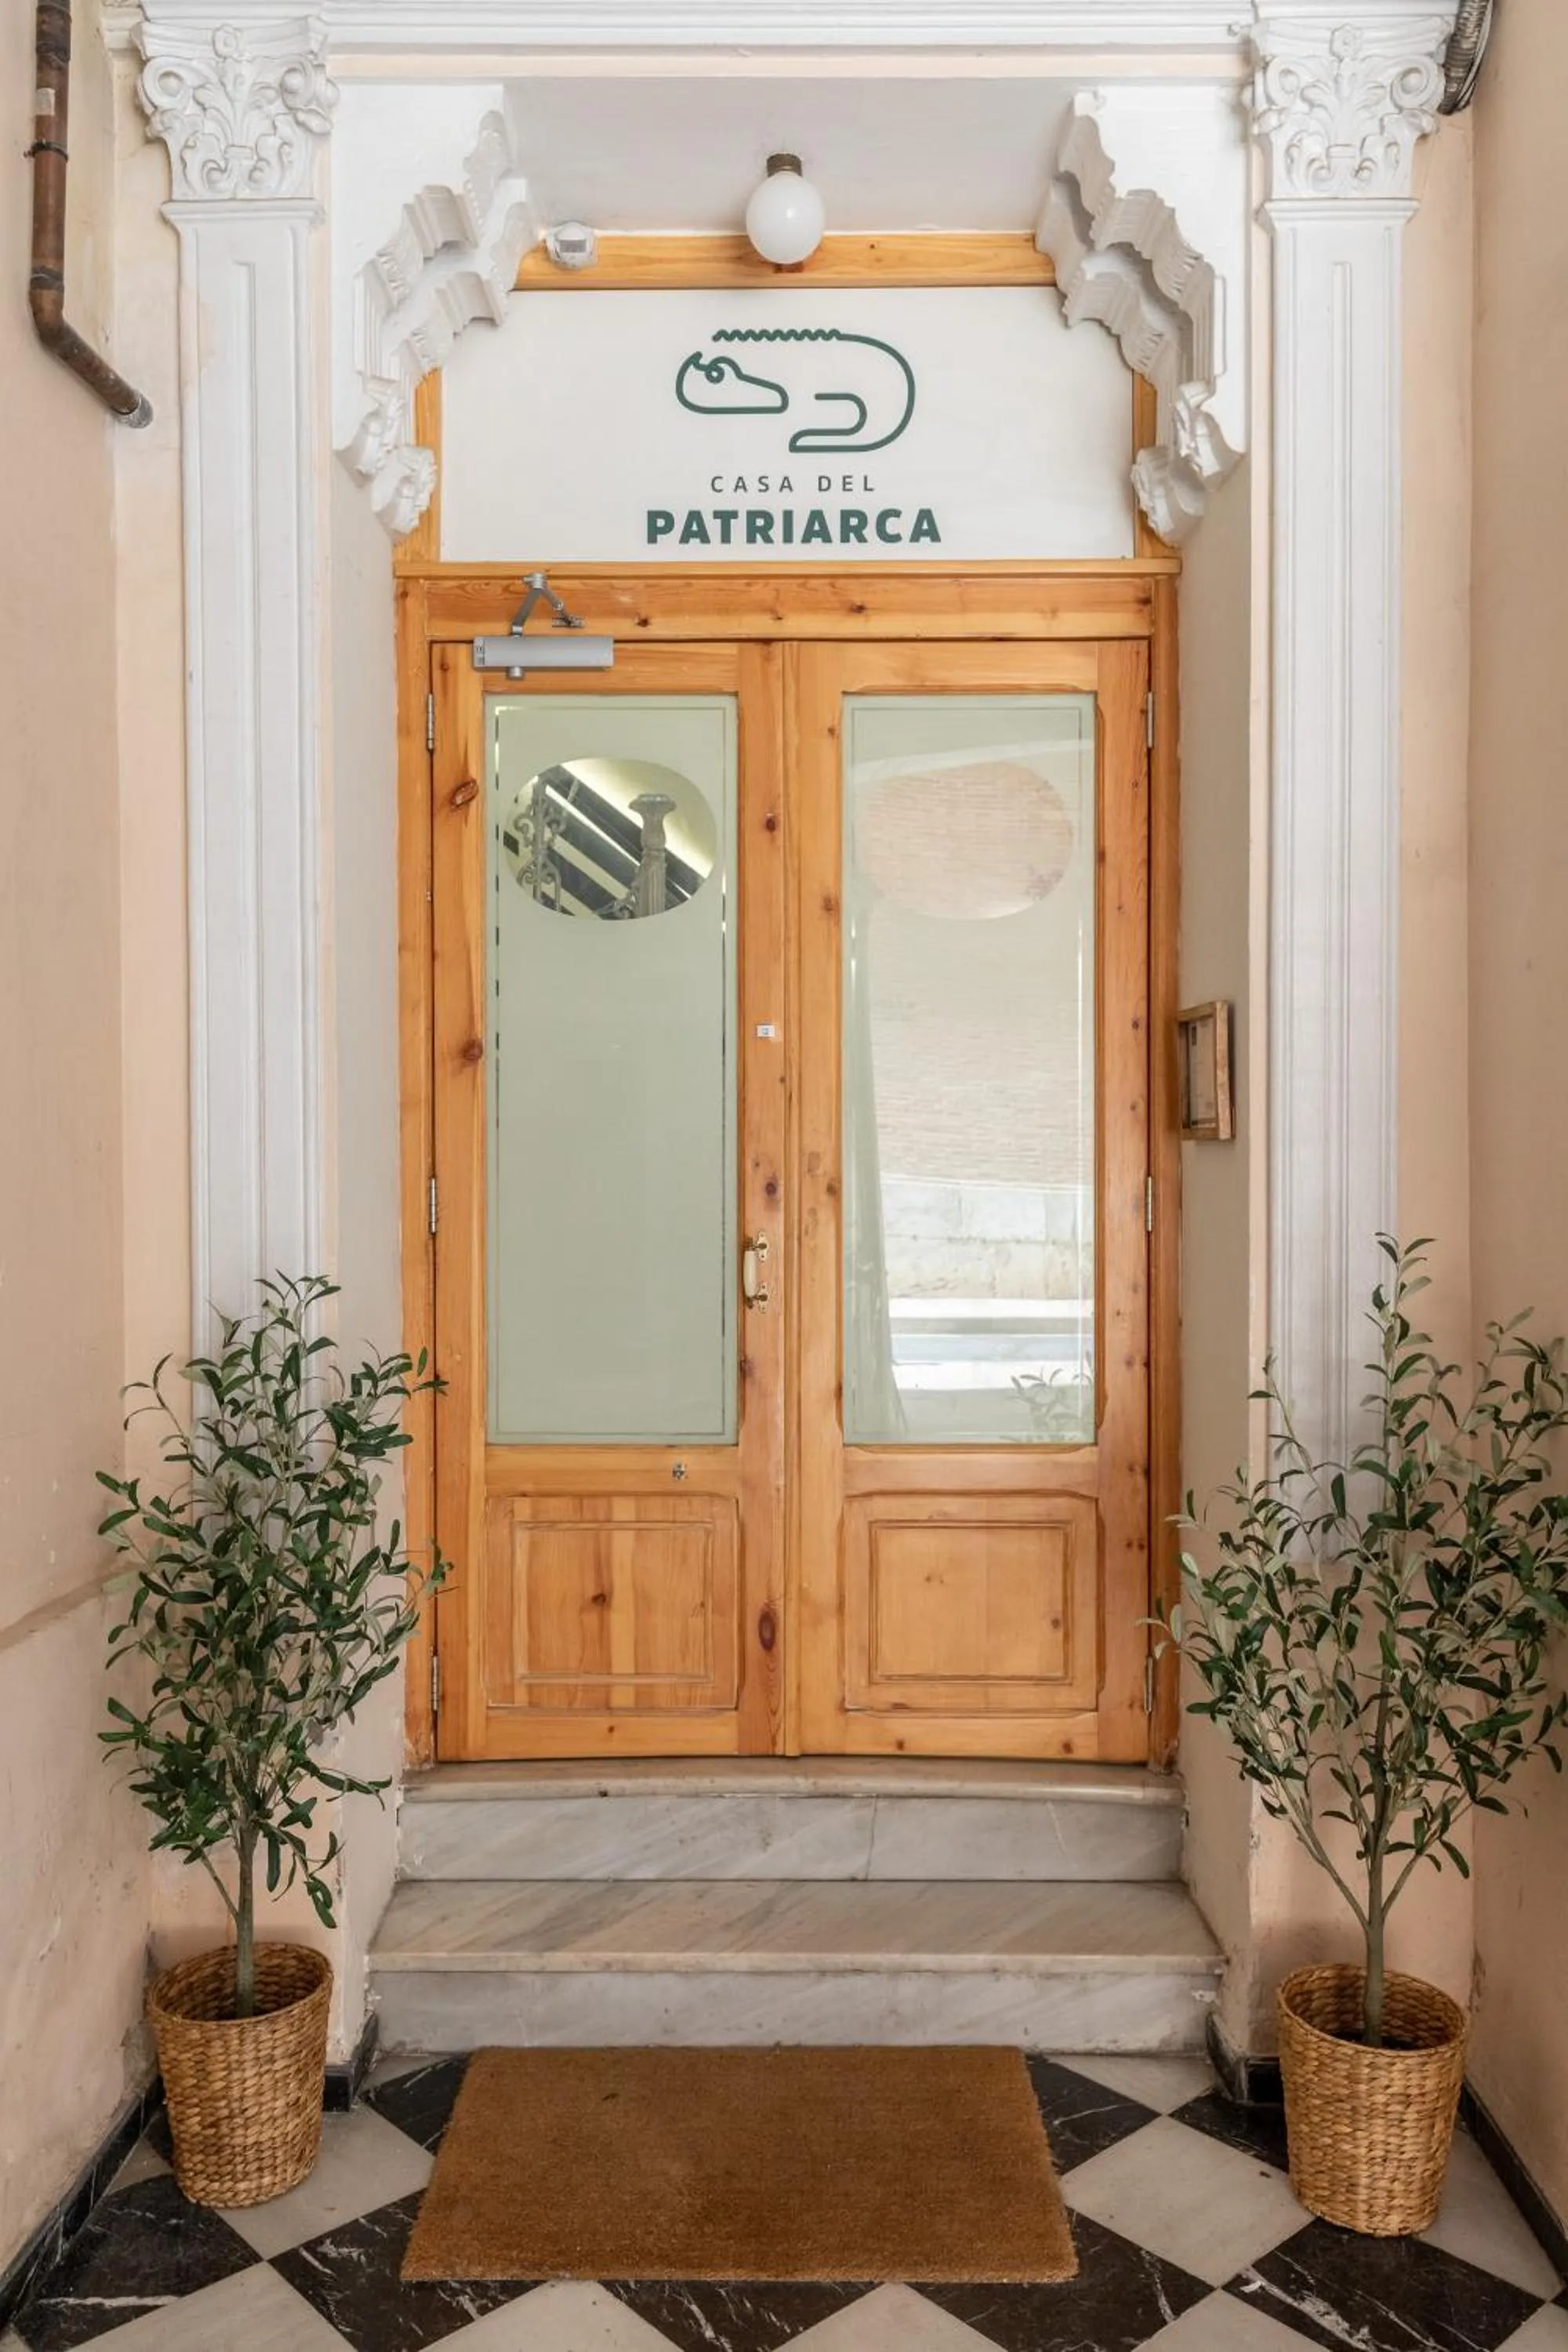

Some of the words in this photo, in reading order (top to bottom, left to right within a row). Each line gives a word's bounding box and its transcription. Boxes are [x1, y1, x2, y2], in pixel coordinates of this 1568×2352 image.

[710, 474, 793, 493] CASA
[818, 474, 875, 493] DEL
[646, 508, 942, 545] PATRIARCA
